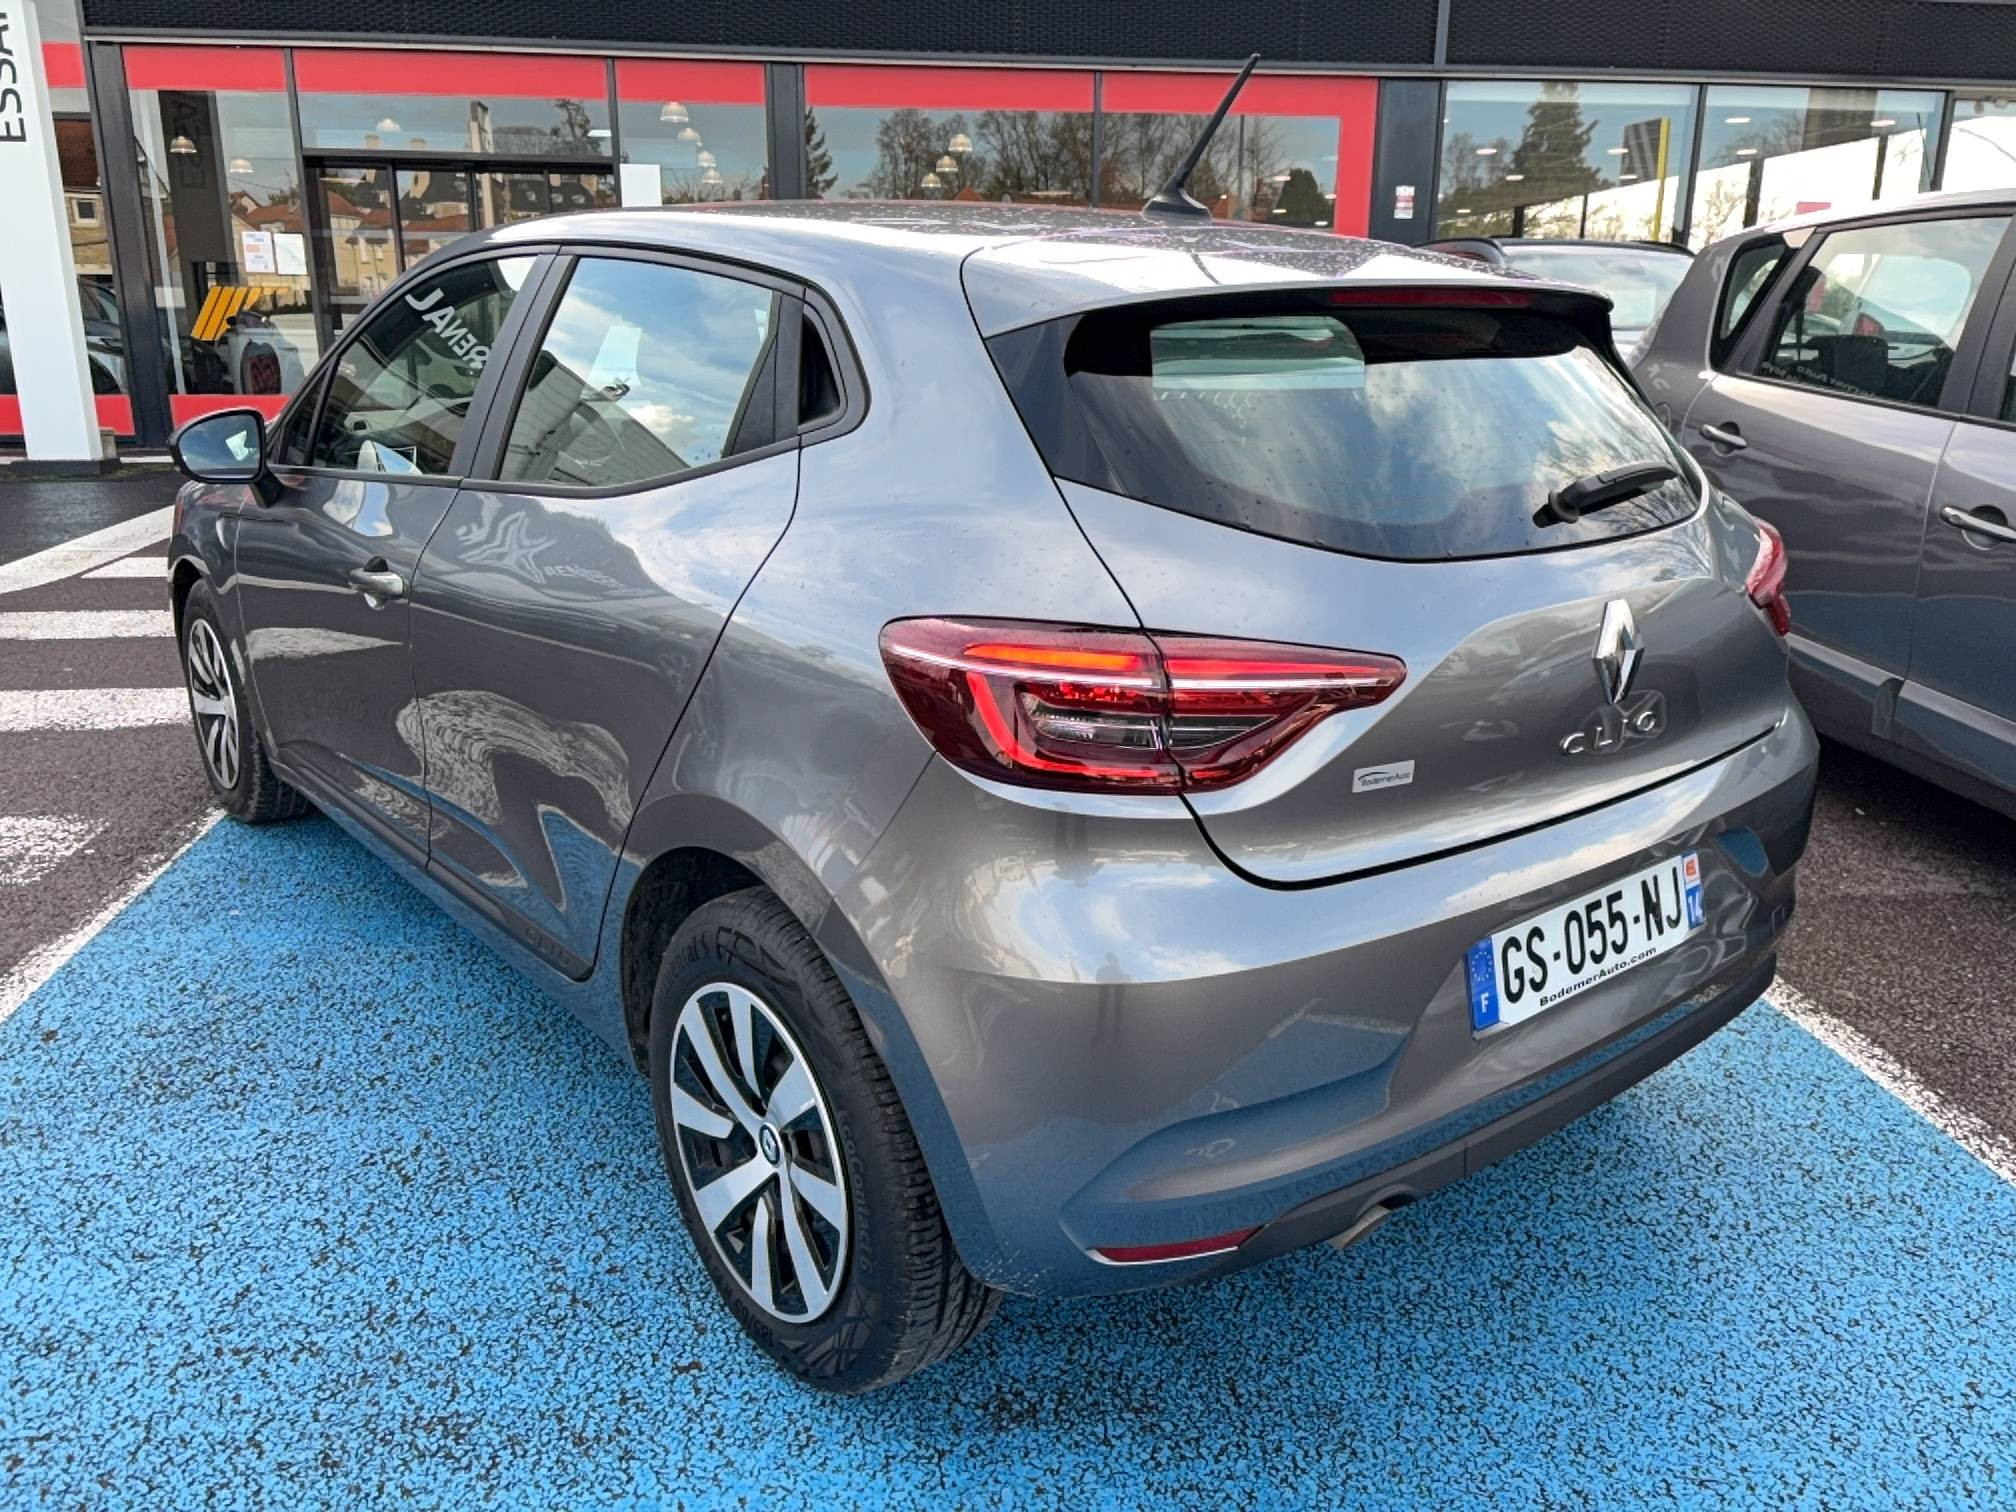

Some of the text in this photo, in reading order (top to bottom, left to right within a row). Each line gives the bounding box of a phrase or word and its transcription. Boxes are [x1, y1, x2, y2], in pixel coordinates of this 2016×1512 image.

[0, 11, 27, 142] ESS
[1561, 711, 1656, 754] CLIO
[1501, 866, 1682, 1003] GS-055-NJ
[1480, 992, 1489, 1013] F
[1539, 947, 1657, 1007] BodemerAuto.com
